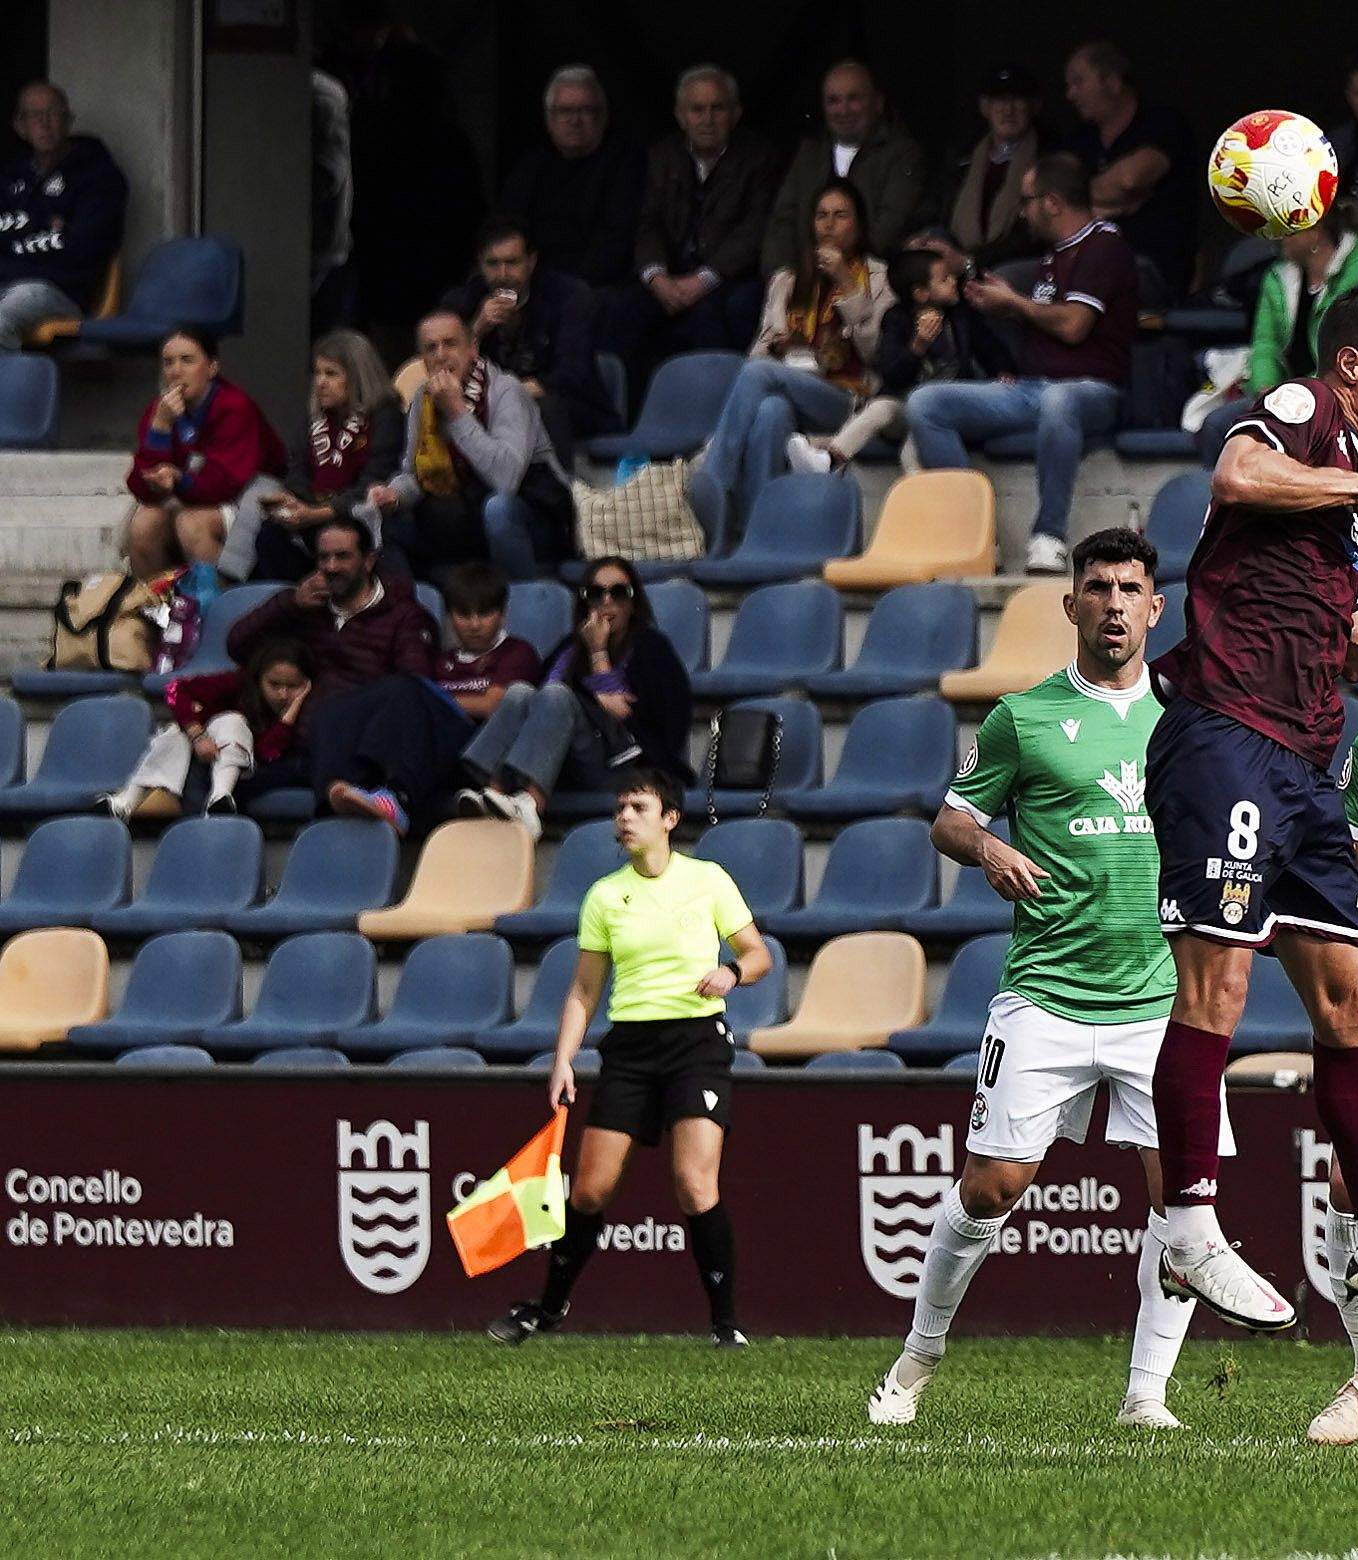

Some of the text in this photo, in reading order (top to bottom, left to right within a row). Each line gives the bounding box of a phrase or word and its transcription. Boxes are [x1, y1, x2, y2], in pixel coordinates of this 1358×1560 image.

[1068, 815, 1155, 836] CAJA RU
[1227, 800, 1260, 860] 8
[1222, 870, 1235, 879] DE
[1223, 861, 1253, 872] XUNTA
[979, 1034, 1006, 1089] 10
[5, 1168, 143, 1204] Concello
[1012, 1176, 1122, 1213] ncello
[7, 1209, 235, 1248] de Pontevedra
[596, 1216, 686, 1252] vedra
[1026, 1220, 1144, 1255] Pontev
